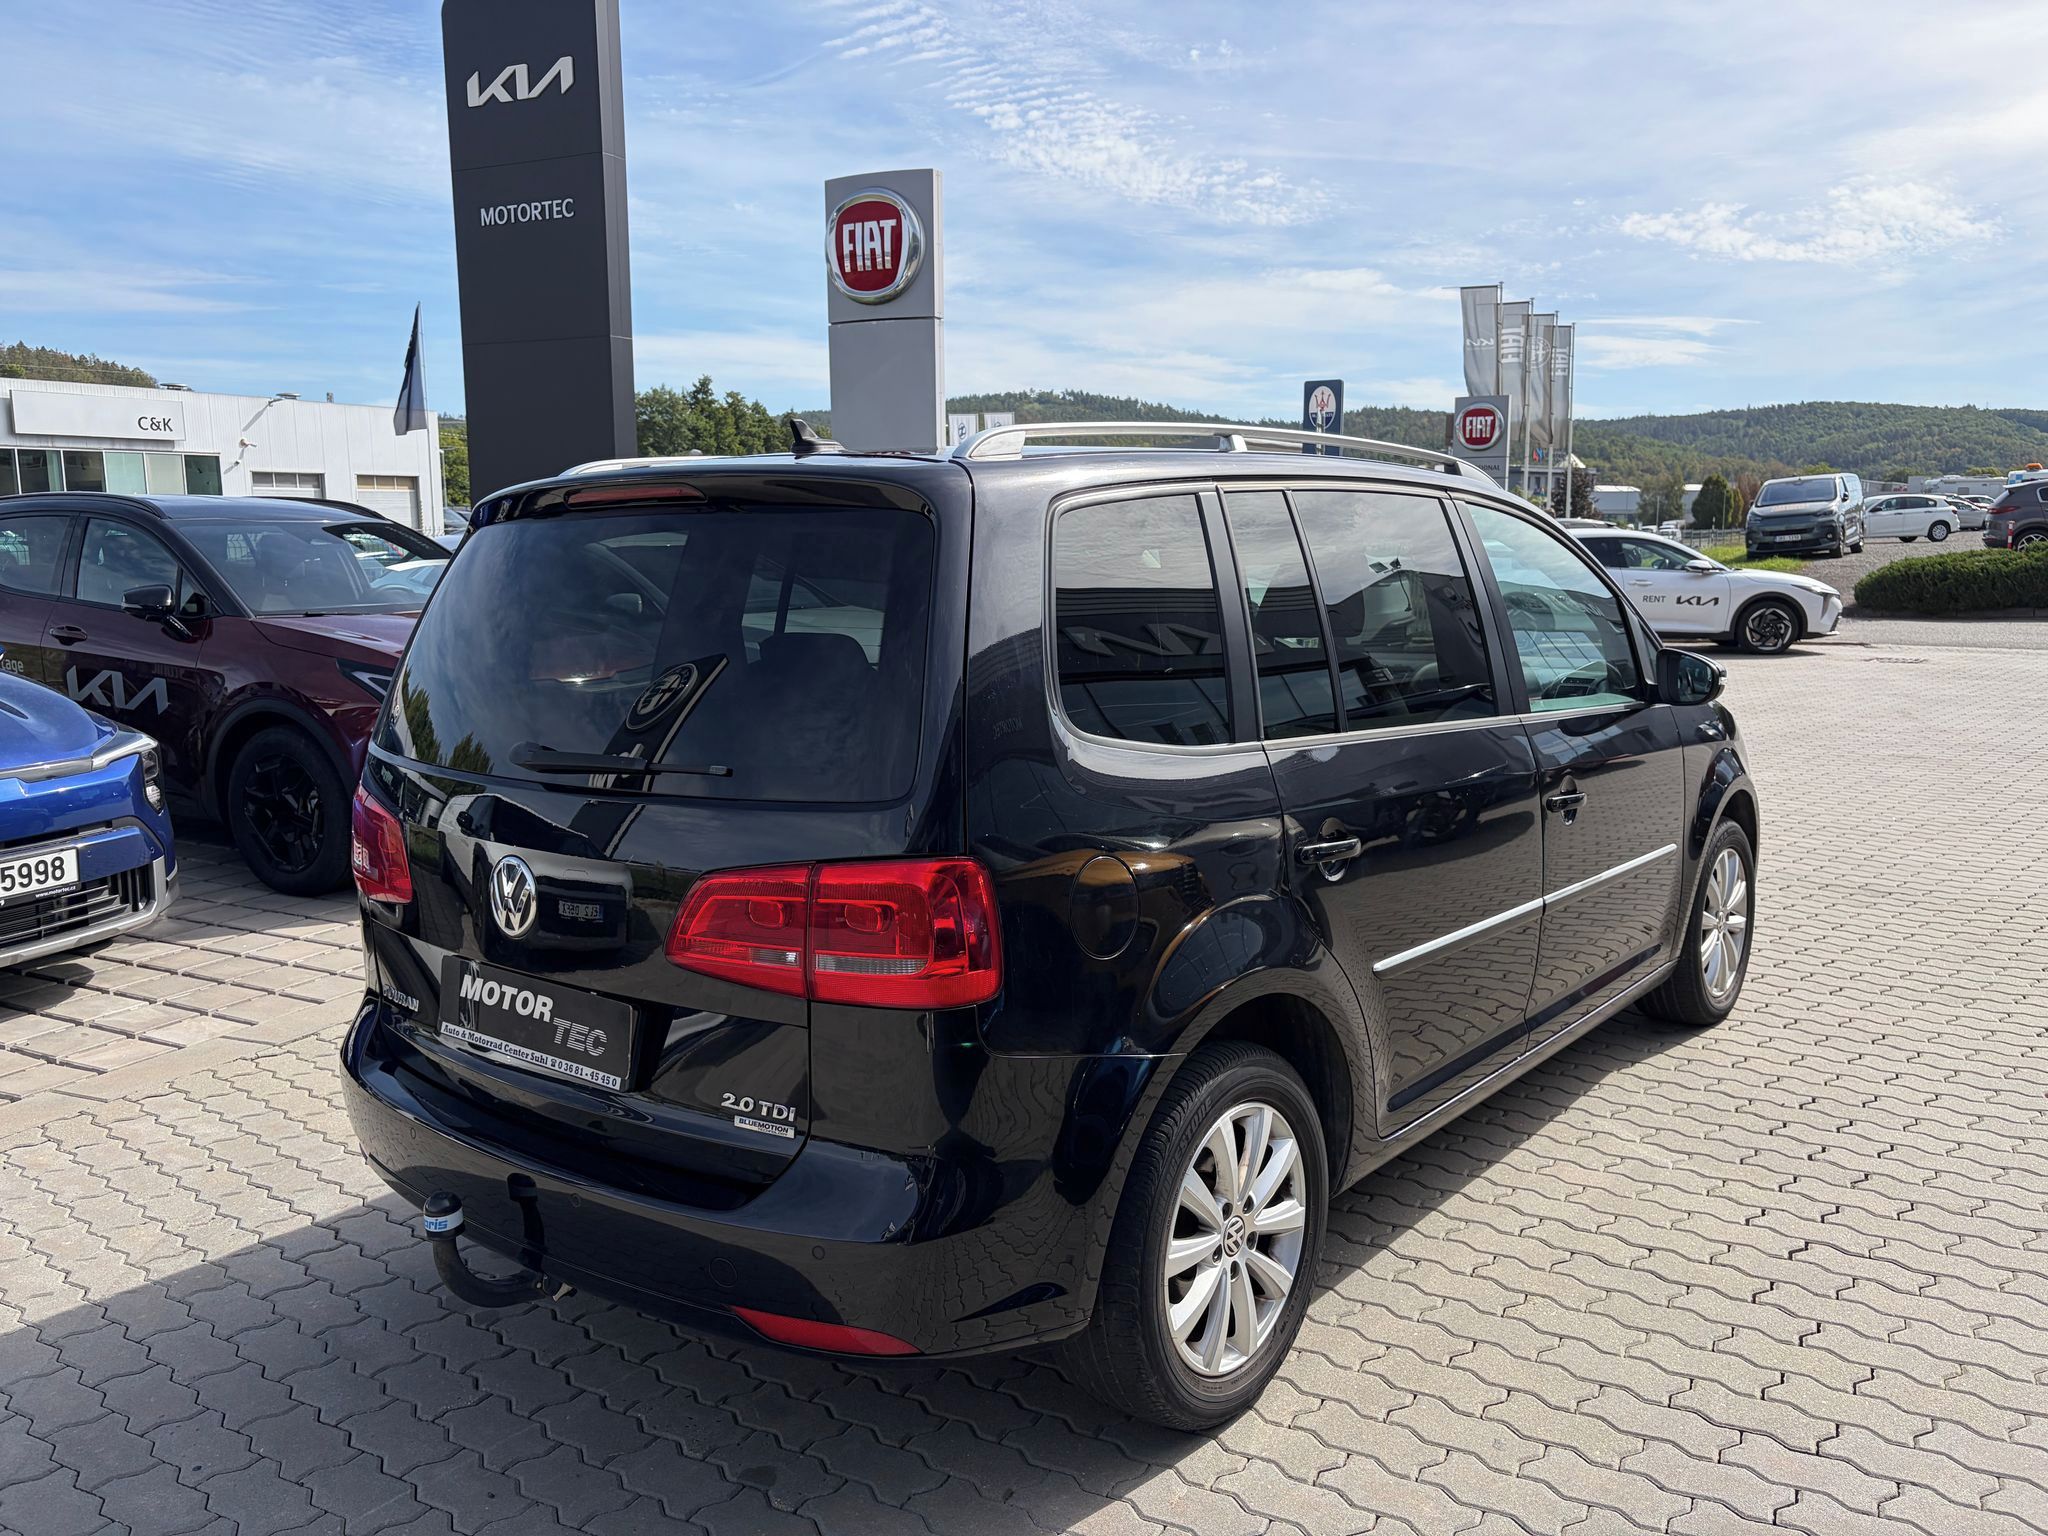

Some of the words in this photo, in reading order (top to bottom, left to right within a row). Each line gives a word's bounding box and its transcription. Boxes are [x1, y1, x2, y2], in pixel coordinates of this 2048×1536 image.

[467, 56, 574, 107] KIA
[480, 198, 575, 226] MOTORTEC
[842, 219, 897, 273] FIAT
[137, 416, 173, 432] C&K
[1465, 416, 1494, 439] FIAT
[1643, 595, 1667, 604] RENT
[1676, 595, 1720, 606] KIA
[66, 665, 172, 716] KIA
[1, 856, 65, 892] 5998
[459, 974, 554, 1022] MOTOR
[443, 1024, 460, 1037] Auto
[461, 1030, 467, 1039] &
[467, 1031, 503, 1050] Motorrad
[504, 1043, 530, 1060] Center
[530, 1052, 548, 1065] Suhl
[553, 1017, 608, 1056] TEC
[739, 1118, 789, 1133] BLUEMOTION
[759, 1100, 797, 1122] TDI
